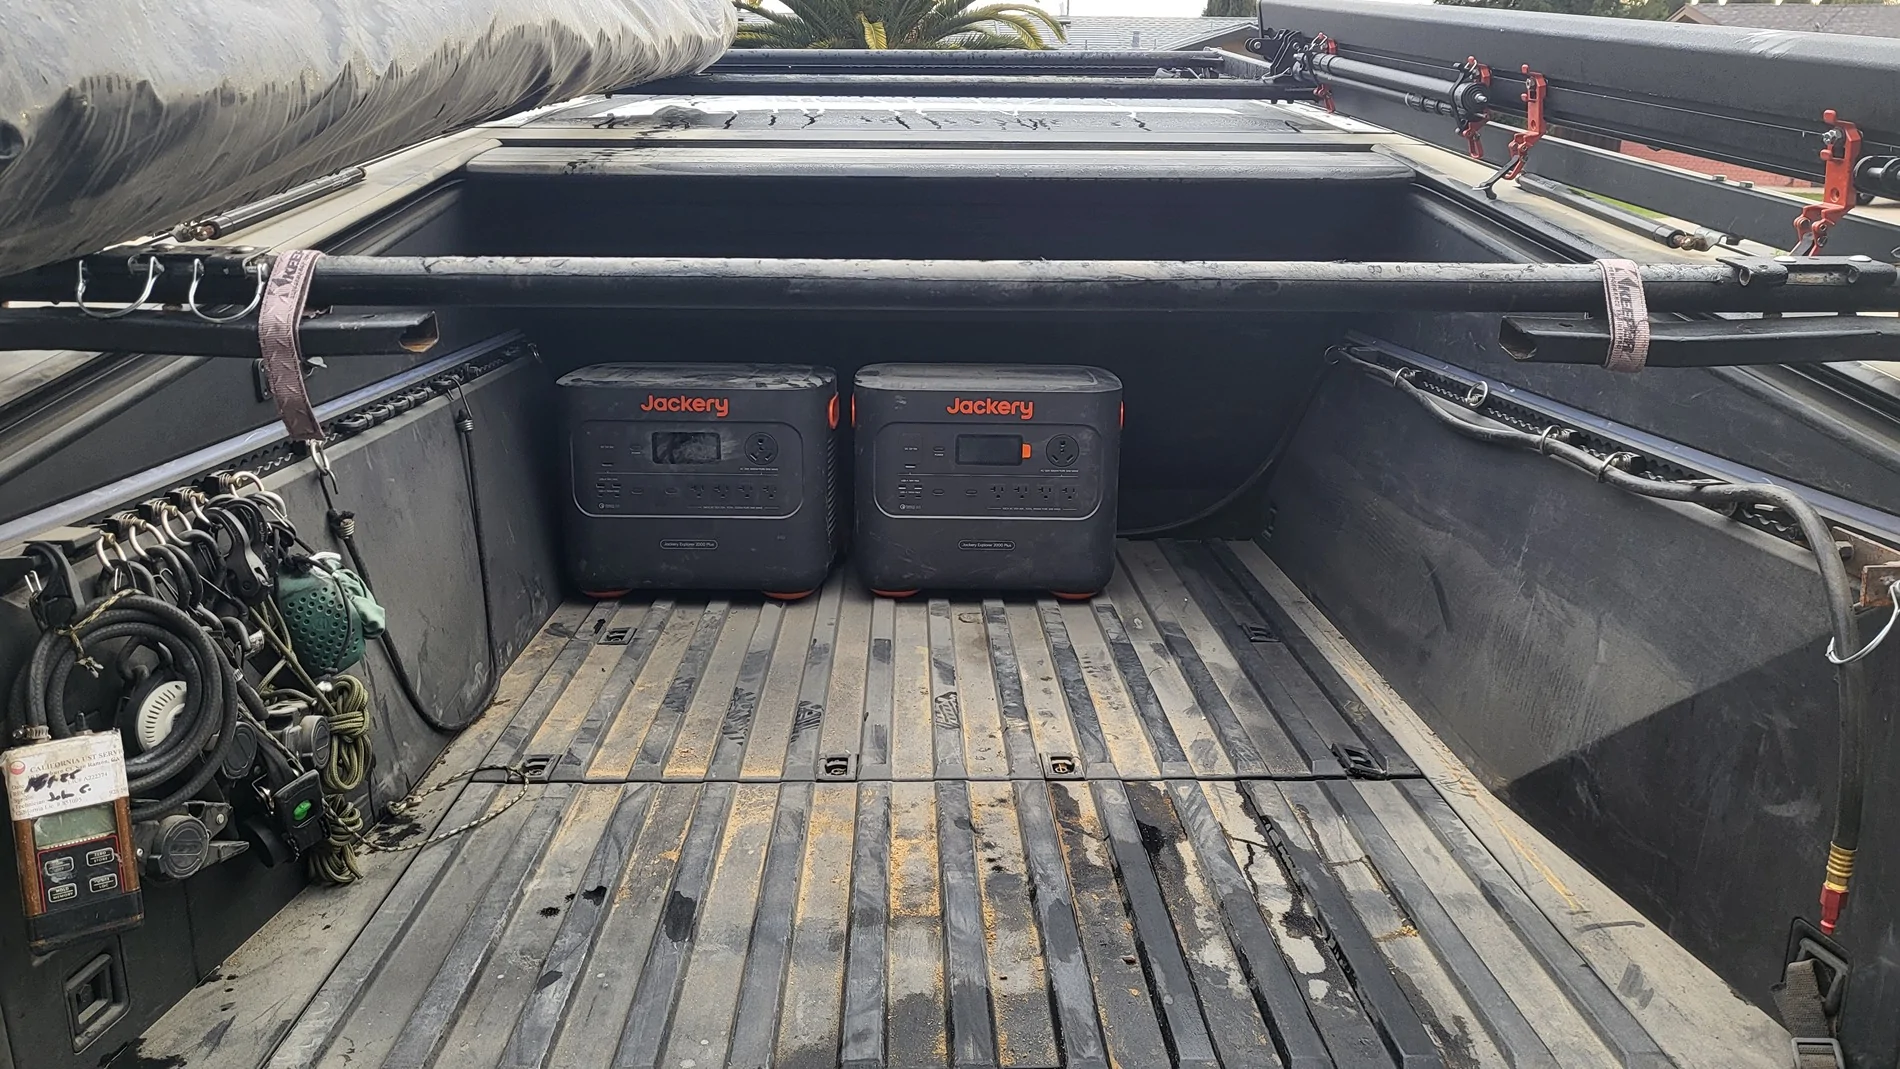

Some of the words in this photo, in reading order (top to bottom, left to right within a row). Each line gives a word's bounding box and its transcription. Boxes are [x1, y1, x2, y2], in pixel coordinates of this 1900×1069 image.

[641, 395, 728, 416] Jackery
[946, 398, 1033, 419] Jackery
[30, 757, 80, 773] CALIFORNIA
[82, 753, 97, 762] UST
